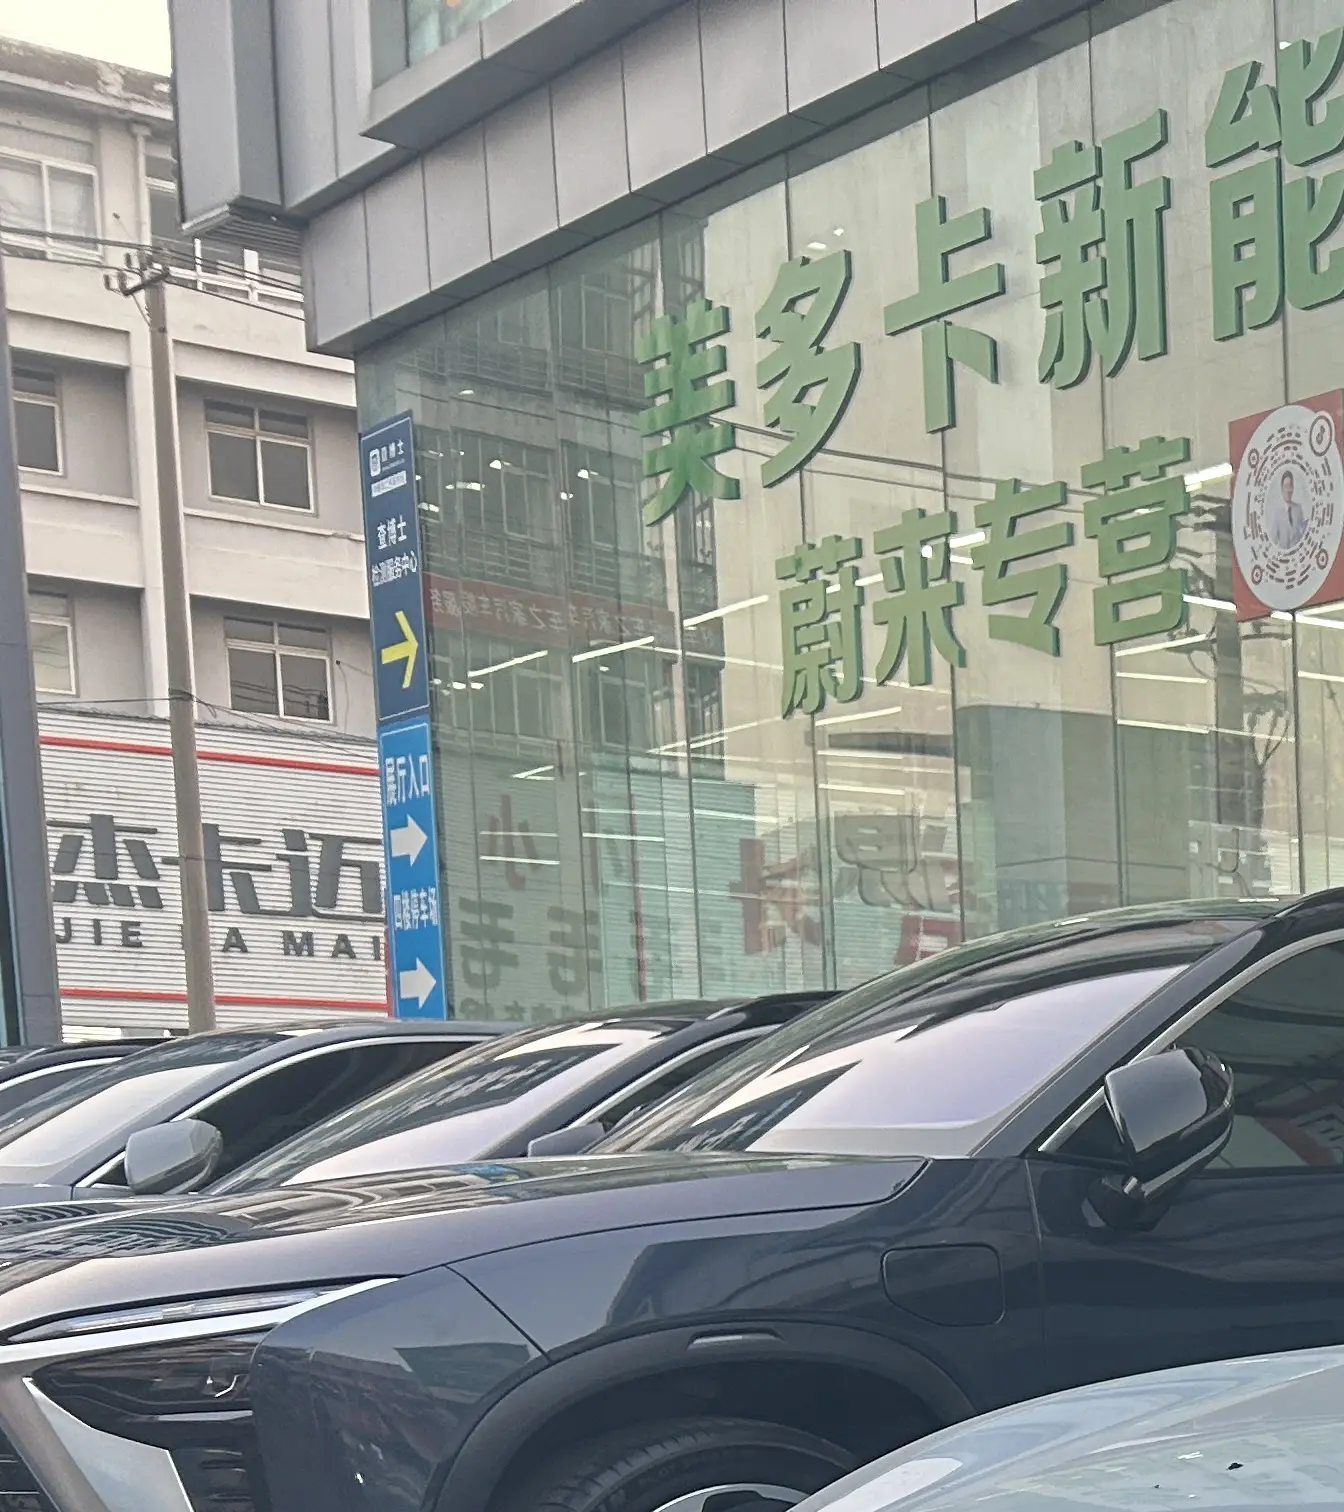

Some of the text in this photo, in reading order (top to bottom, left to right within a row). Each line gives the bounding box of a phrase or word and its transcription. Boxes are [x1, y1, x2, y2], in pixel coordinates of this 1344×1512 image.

[377, 514, 407, 549] 查博士
[775, 435, 1190, 720] 蔚来专营
[385, 753, 430, 806] 展厅入口
[54, 917, 144, 948] JIE
[282, 930, 383, 961] MAI
